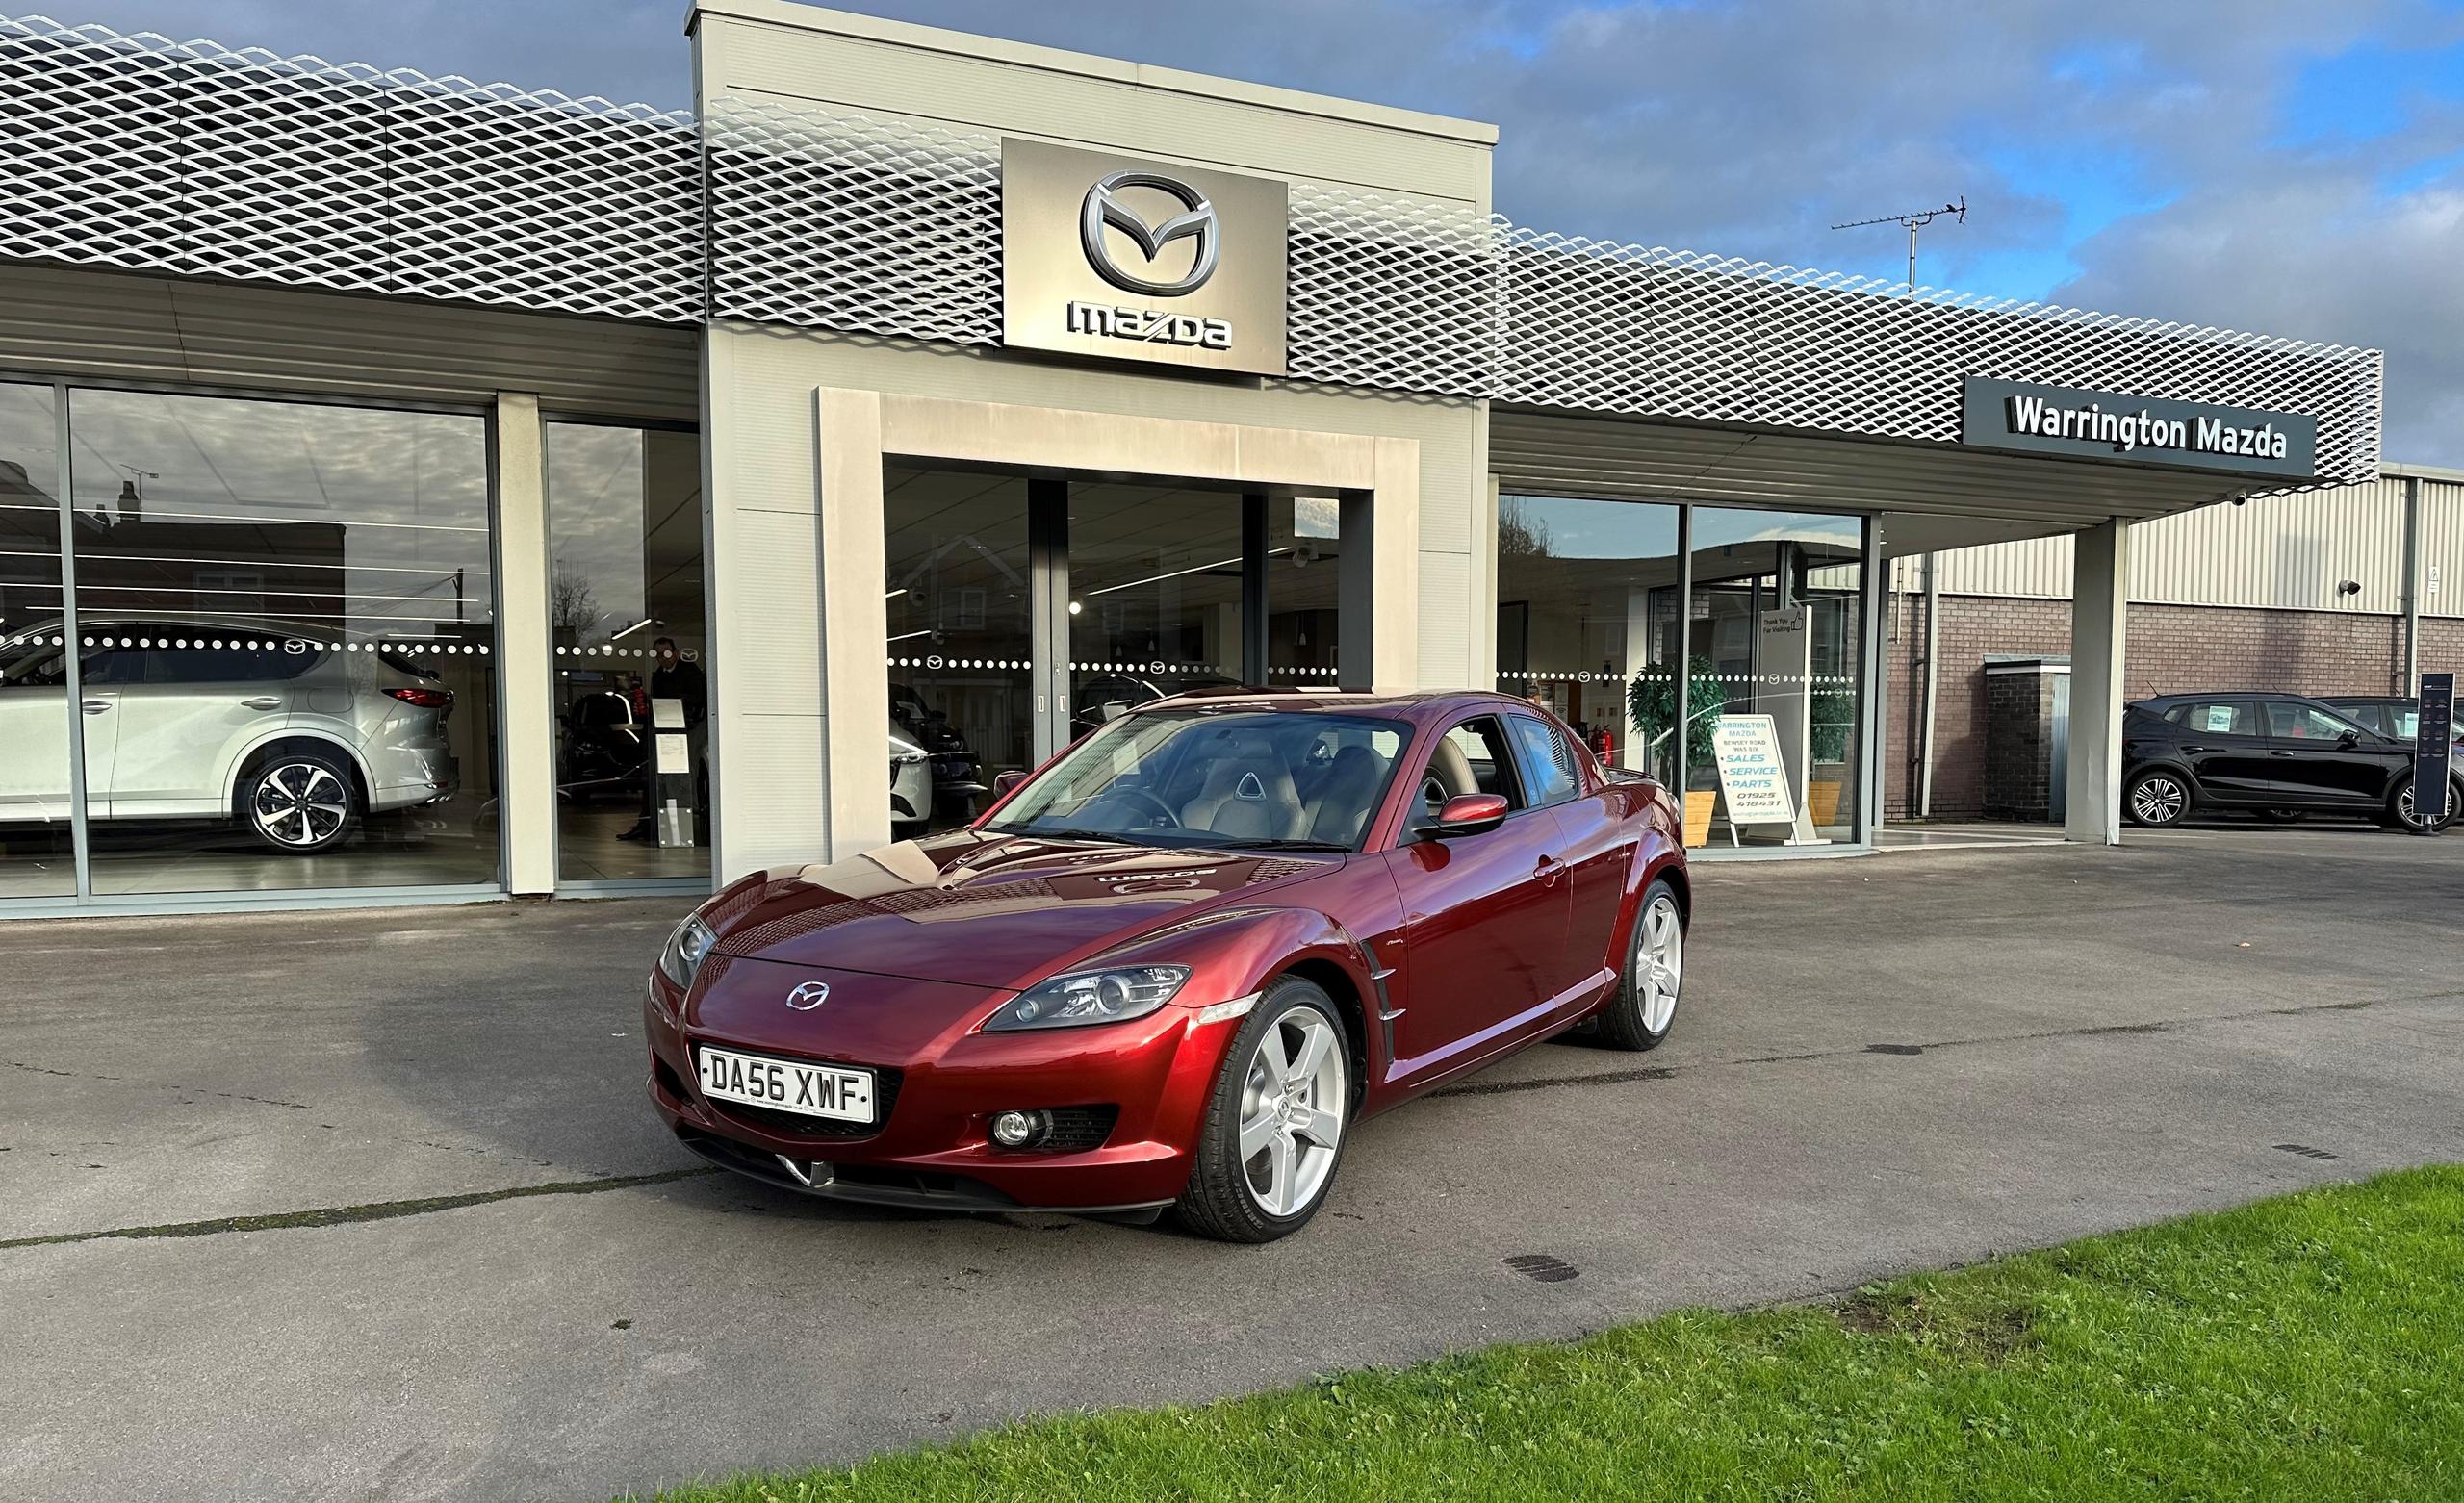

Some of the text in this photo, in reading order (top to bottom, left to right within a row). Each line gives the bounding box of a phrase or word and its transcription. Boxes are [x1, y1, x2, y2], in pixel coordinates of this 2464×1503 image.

[2011, 395, 2288, 459] Warrington Mazda
[1726, 754, 1765, 763] SALES
[1729, 767, 1779, 776] SERVICE
[1732, 779, 1772, 788] PARTS
[710, 1055, 860, 1111] DA56 XWF
